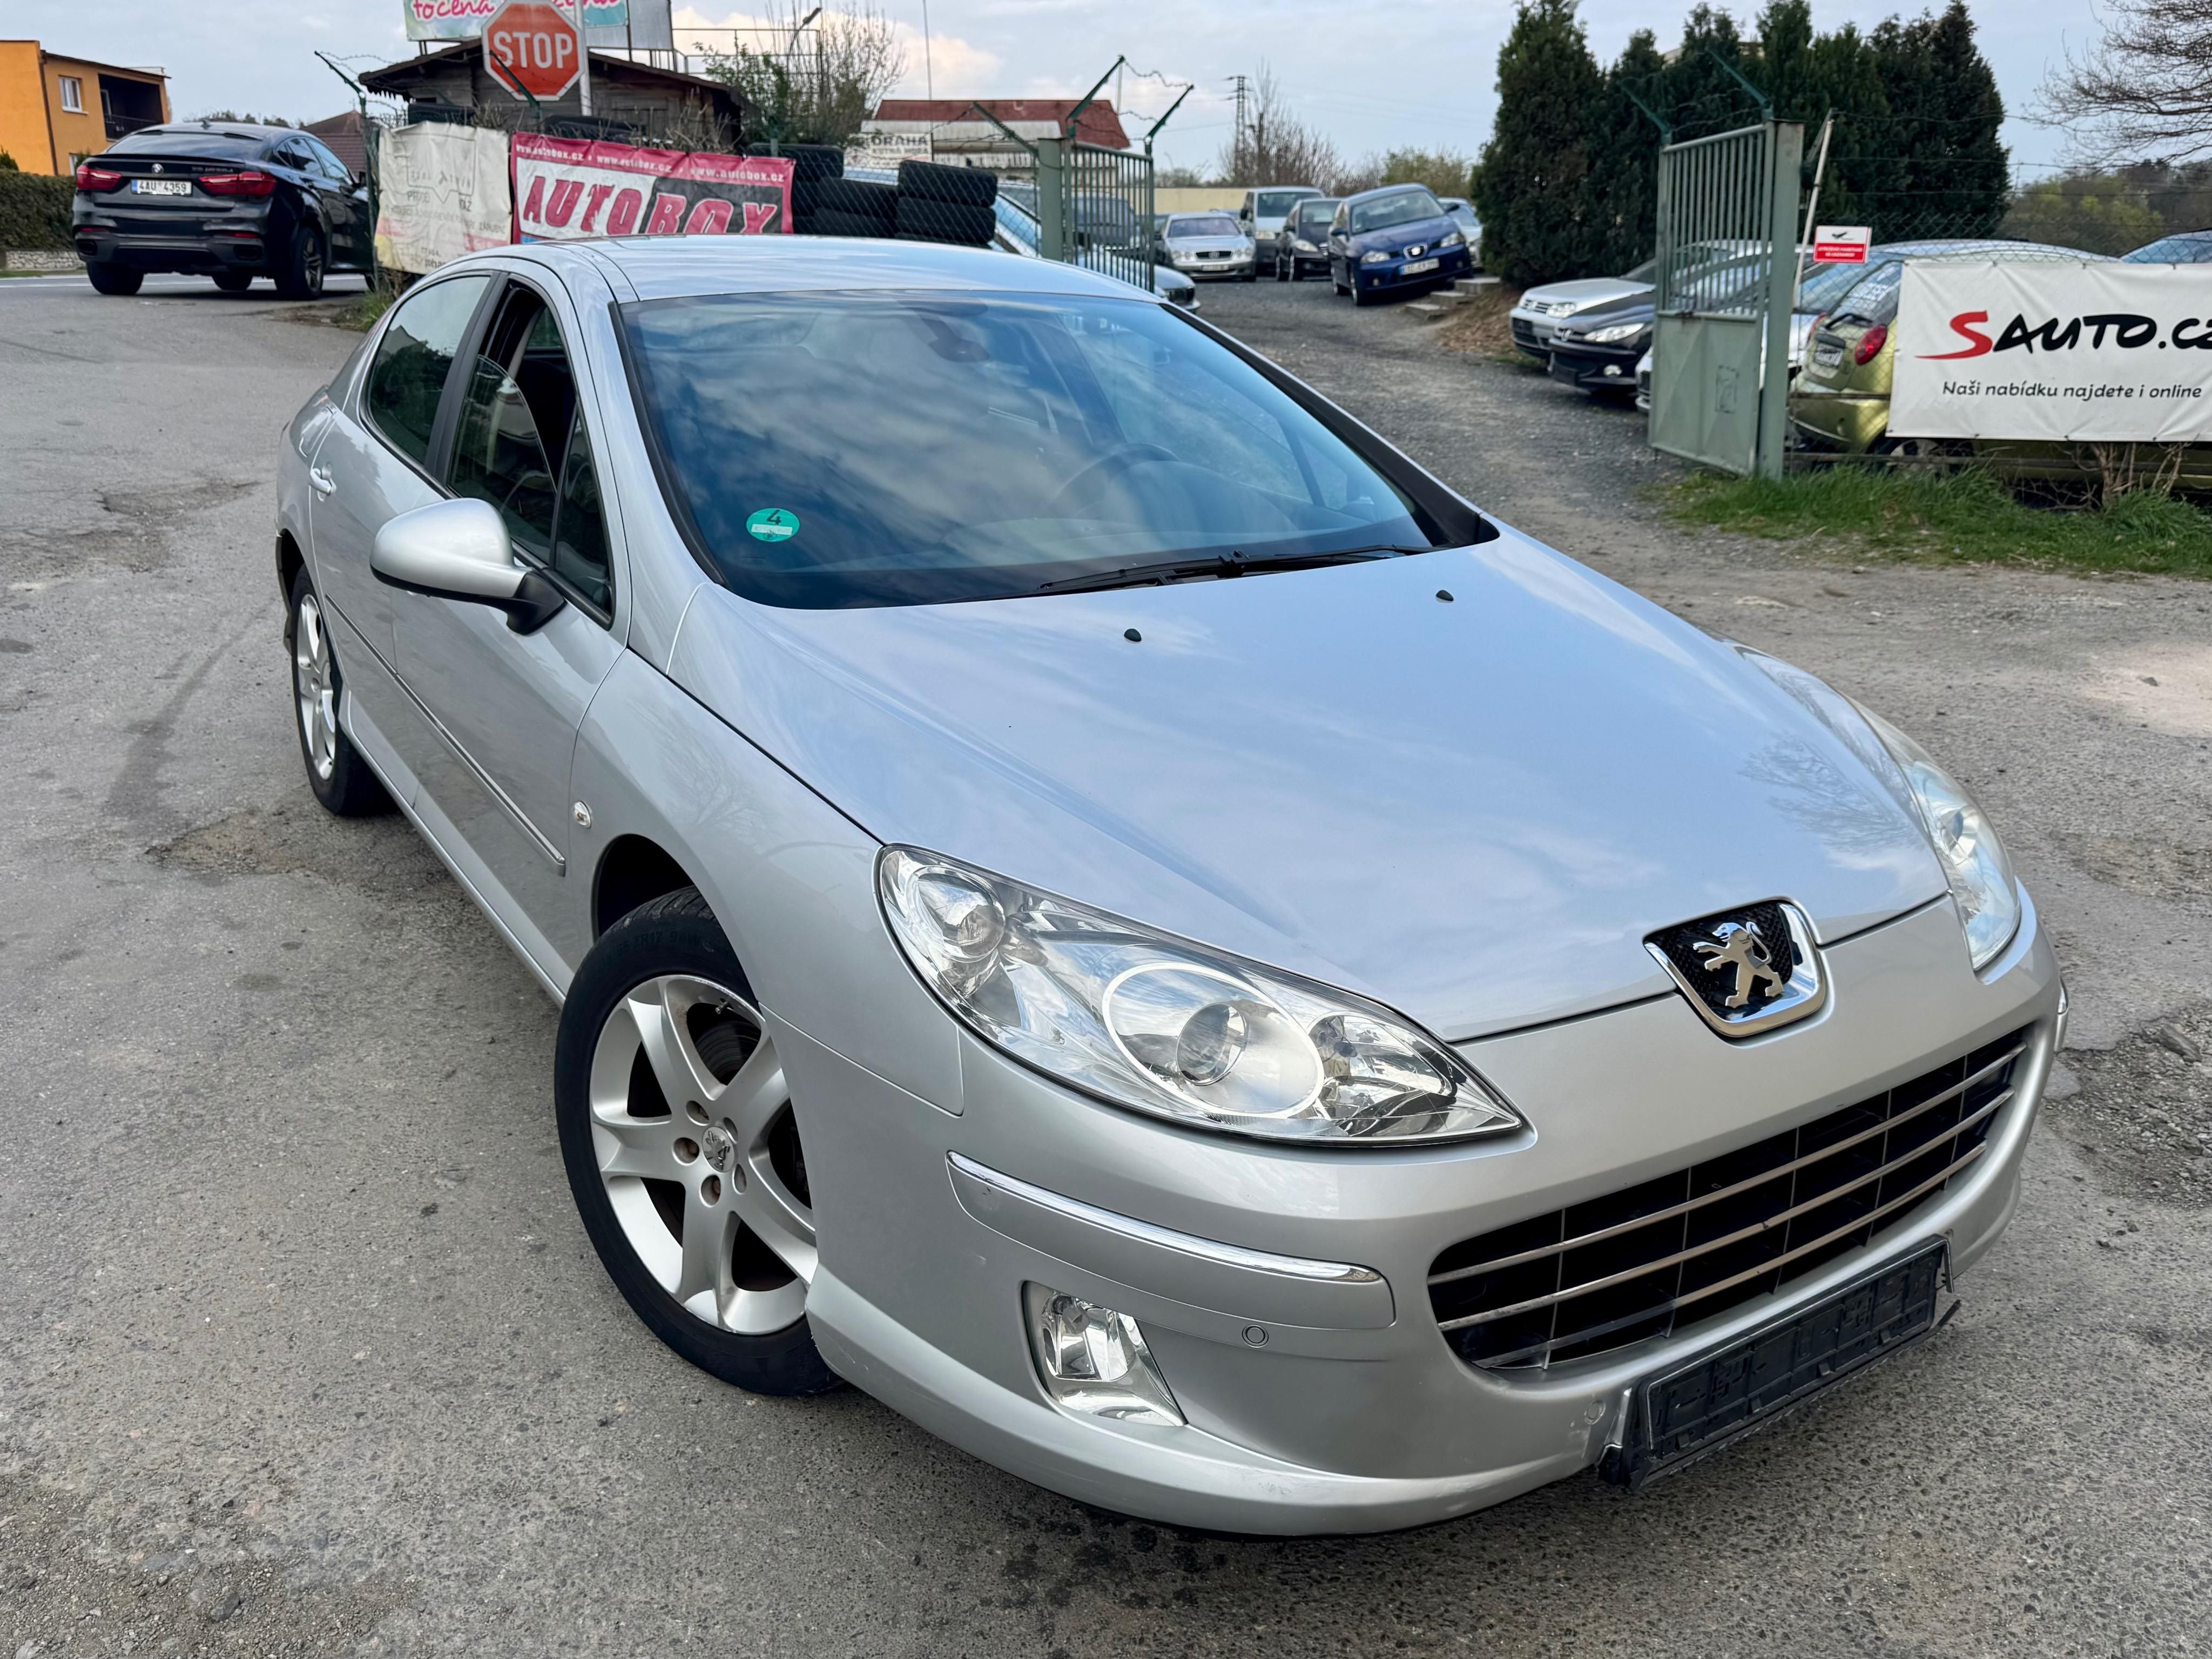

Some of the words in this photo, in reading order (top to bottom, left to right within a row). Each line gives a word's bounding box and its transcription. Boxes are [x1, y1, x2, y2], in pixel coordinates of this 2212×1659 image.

[493, 30, 572, 69] STOP
[690, 167, 784, 182] www.autobox.cz
[139, 181, 157, 192] 4AU
[164, 183, 187, 193] 4359
[523, 176, 778, 235] AUTOBOX
[1943, 379, 1981, 395] Naši
[1985, 380, 2058, 396] nabídku
[2063, 384, 2134, 401] najdete
[2139, 384, 2145, 397] i
[2149, 385, 2202, 398] online
[766, 509, 781, 525] 4
